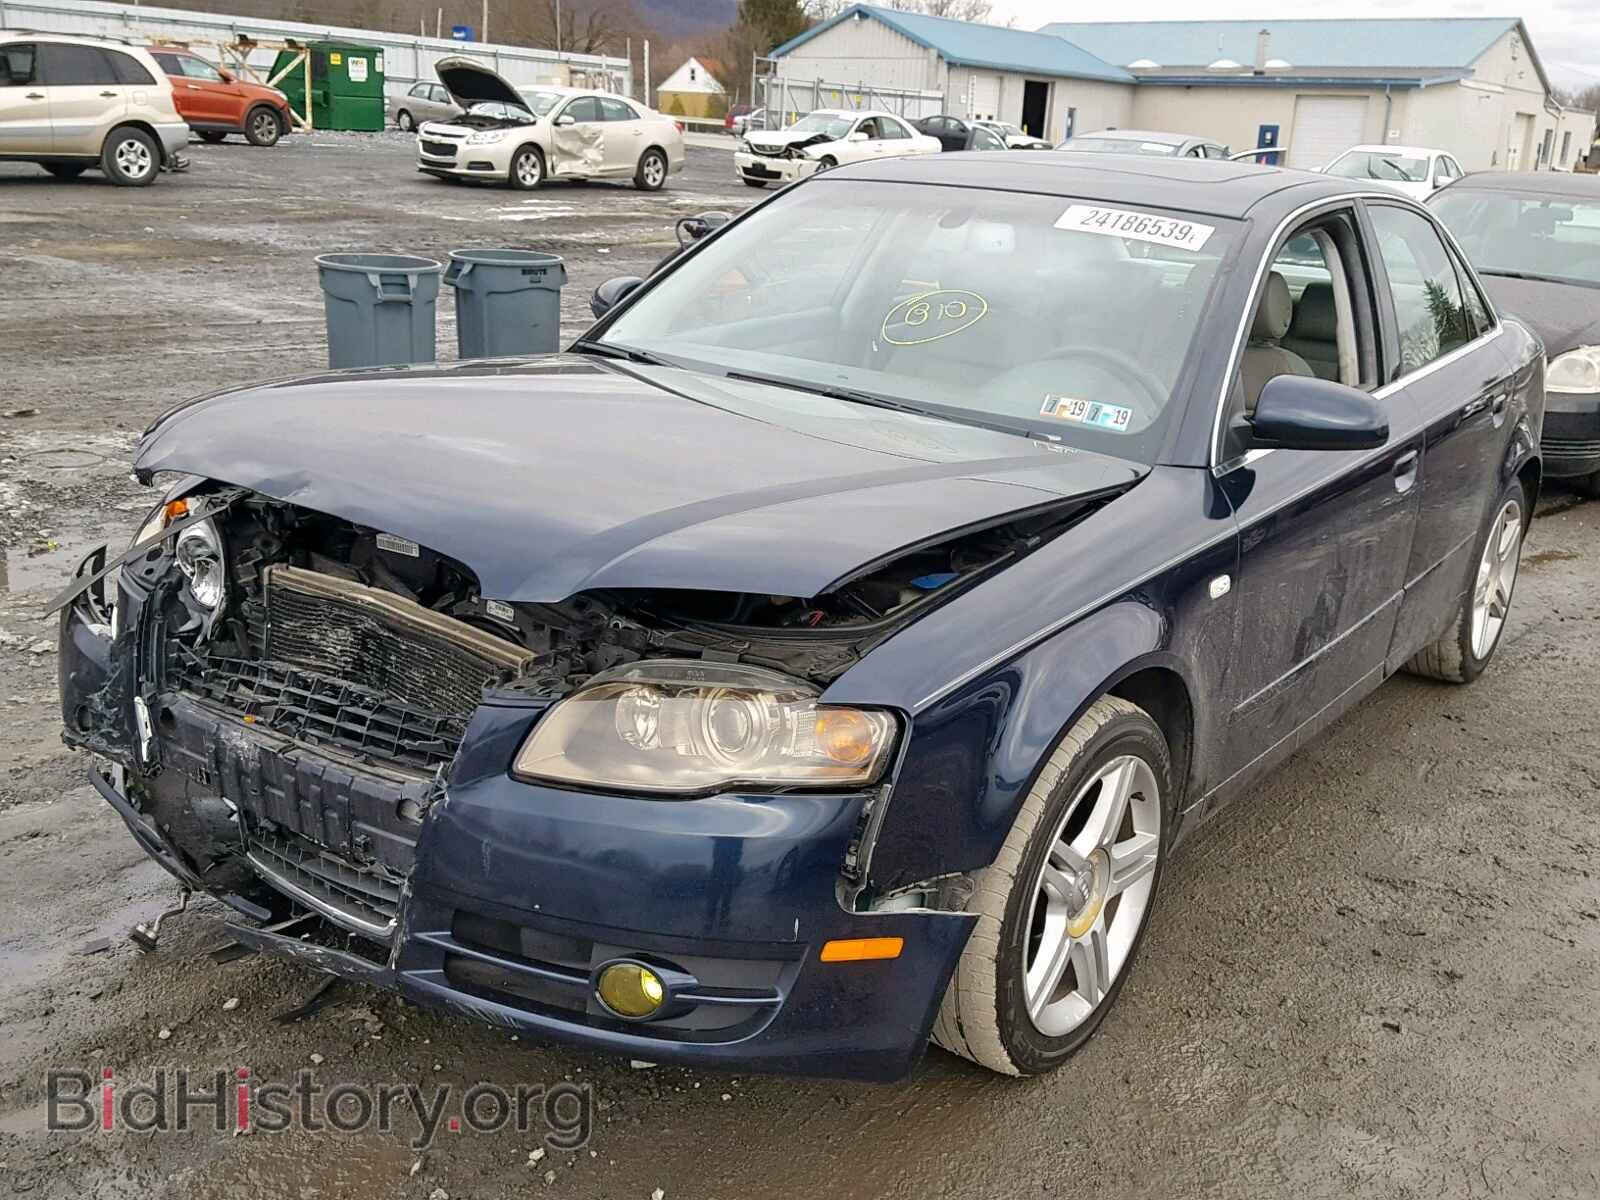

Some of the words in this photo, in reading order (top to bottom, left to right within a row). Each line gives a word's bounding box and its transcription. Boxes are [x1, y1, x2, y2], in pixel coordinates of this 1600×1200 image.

[1080, 209, 1193, 242] 24186539
[1070, 400, 1087, 417] 19
[1113, 408, 1130, 426] 19
